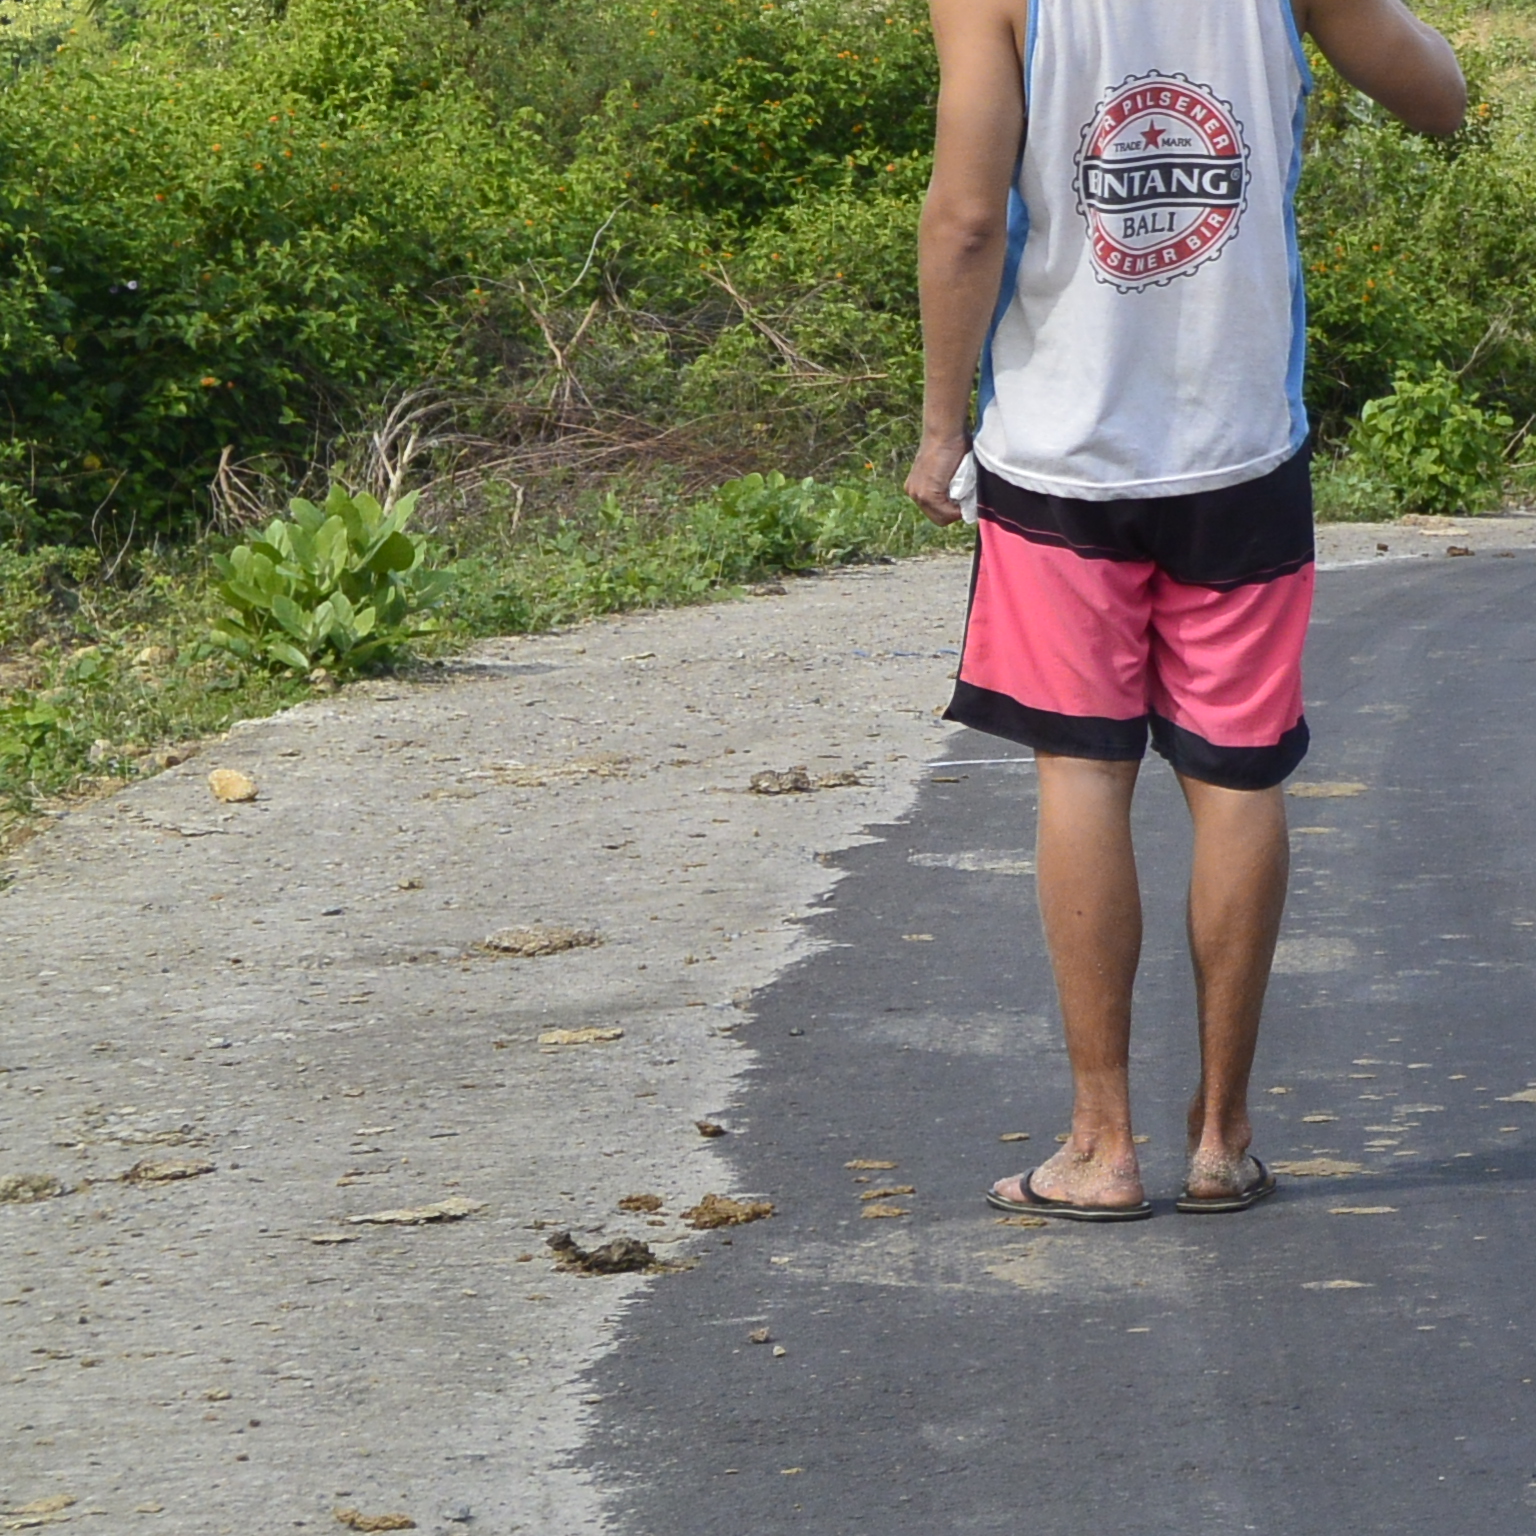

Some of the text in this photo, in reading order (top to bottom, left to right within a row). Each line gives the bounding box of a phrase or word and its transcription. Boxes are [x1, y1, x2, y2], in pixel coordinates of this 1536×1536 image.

[1122, 91, 1229, 149] PILSENER
[1113, 137, 1192, 153] TRADE MARK
[1122, 212, 1176, 239] BALI
[1186, 213, 1224, 251] BIR
